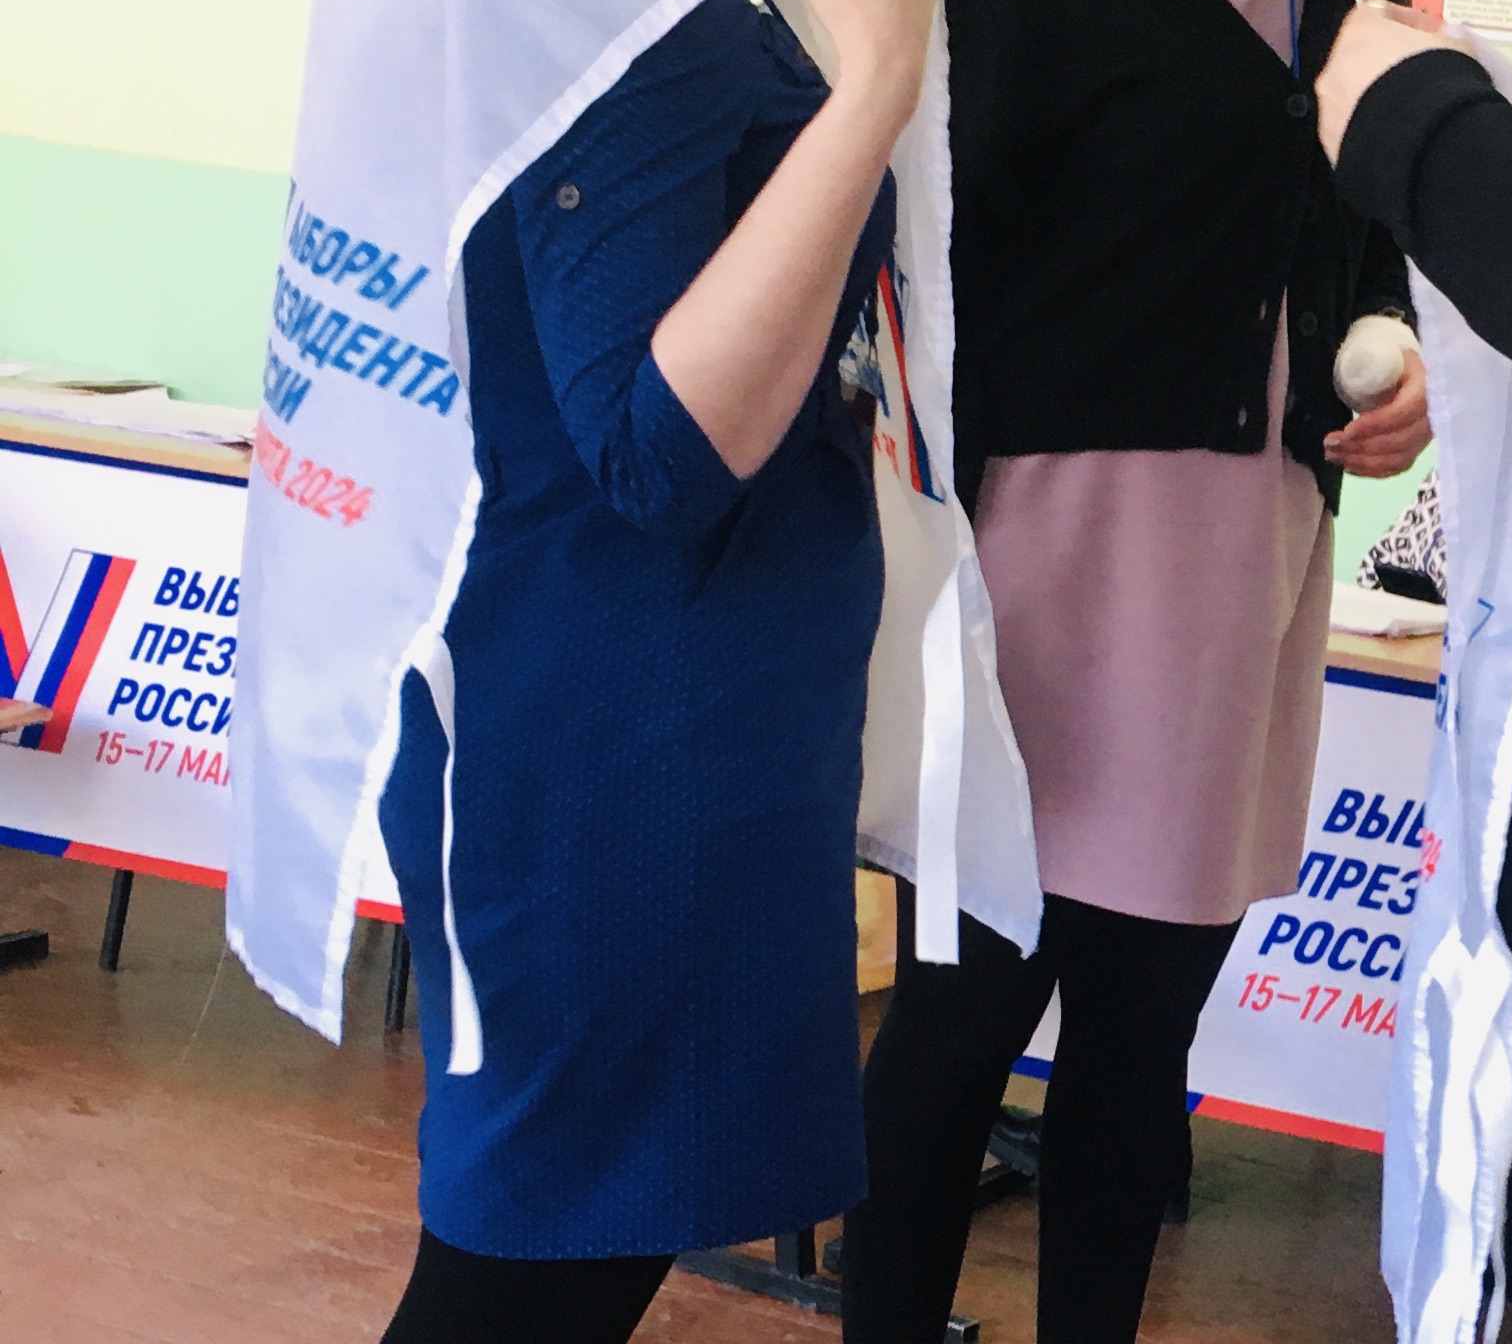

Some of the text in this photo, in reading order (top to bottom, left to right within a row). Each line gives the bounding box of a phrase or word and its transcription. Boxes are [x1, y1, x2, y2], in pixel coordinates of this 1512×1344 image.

[283, 458, 374, 527] 2024
[153, 566, 240, 617] ВЫБ
[130, 621, 237, 679] ПРЕЗ
[107, 677, 232, 737] РОССИ
[176, 745, 231, 787] МА
[1298, 850, 1421, 915] ПРЕЗ
[1258, 913, 1408, 983] РОСС
[1341, 992, 1398, 1038] МА
